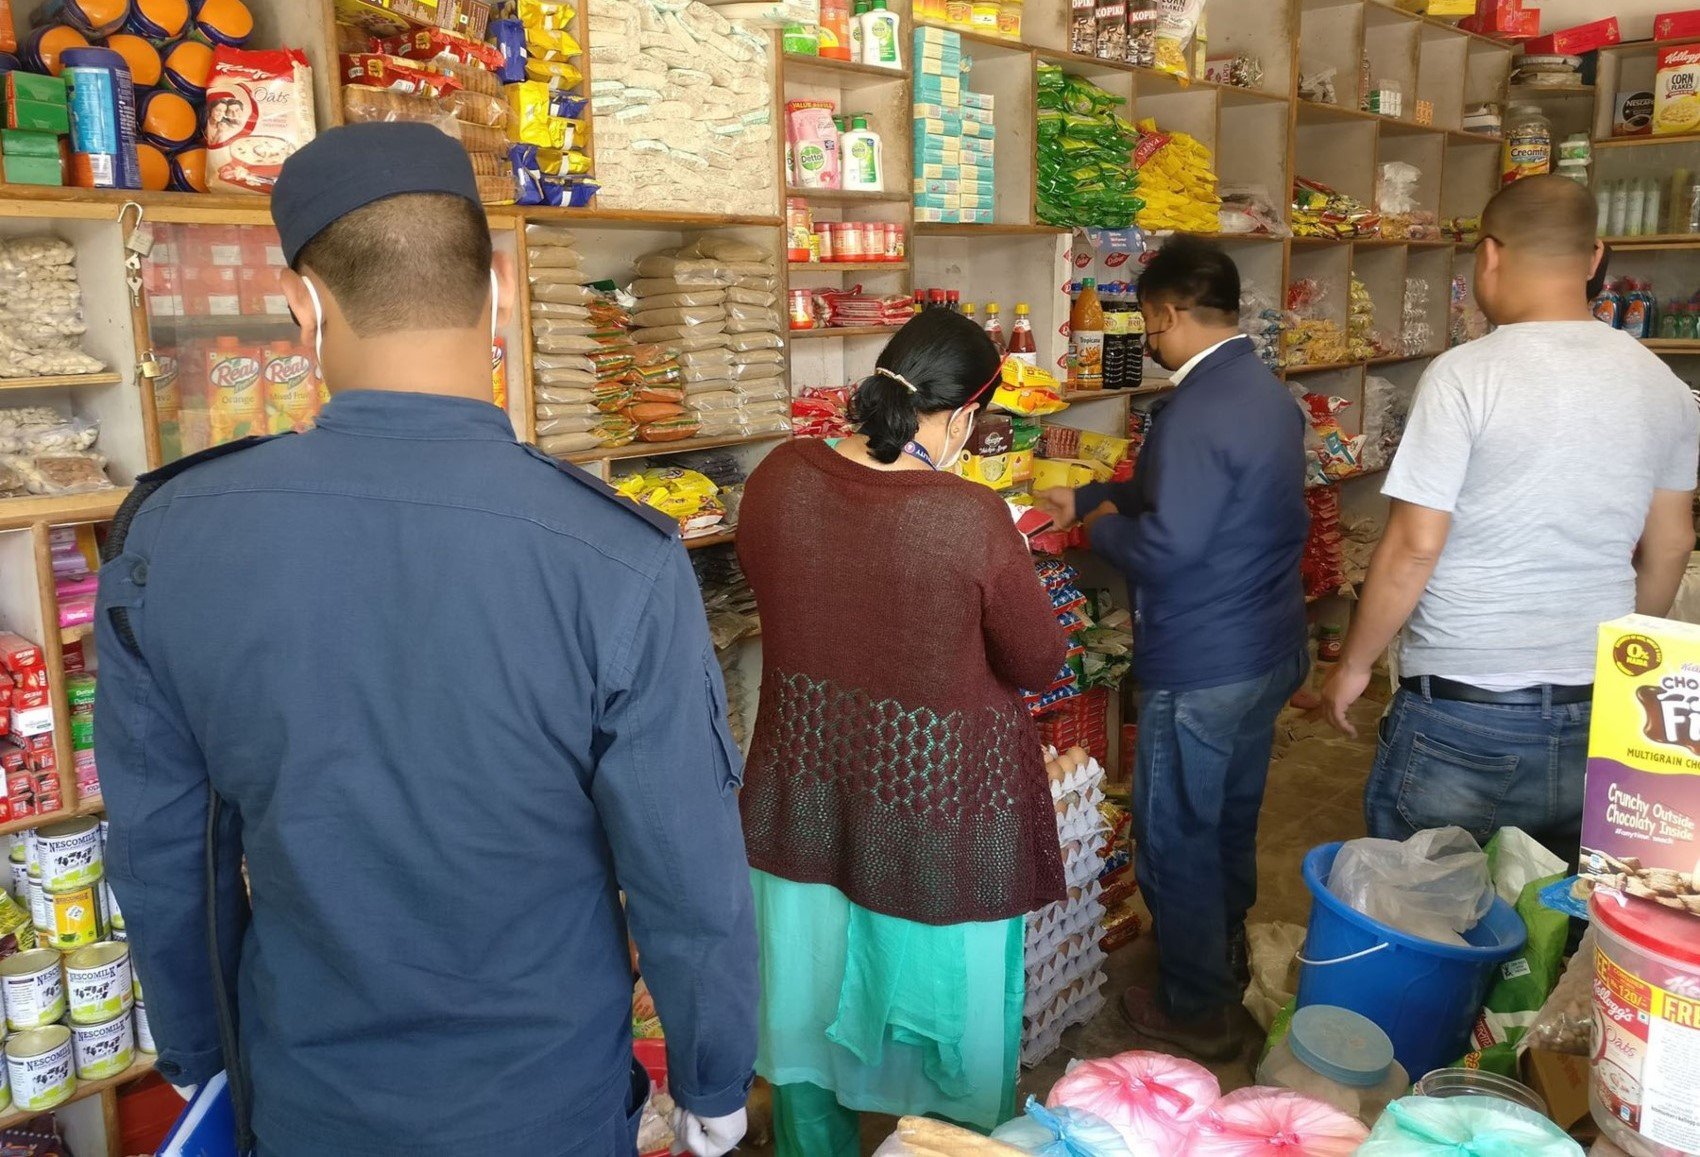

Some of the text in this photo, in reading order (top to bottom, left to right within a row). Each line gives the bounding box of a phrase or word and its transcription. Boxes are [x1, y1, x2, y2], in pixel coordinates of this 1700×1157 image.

[1671, 73, 1694, 85] CORN
[254, 86, 290, 103] Oats
[801, 153, 824, 163] Dettol
[217, 359, 256, 385] Real
[271, 358, 305, 381] Real
[1627, 748, 1683, 767] MULTIGRAIN
[1608, 782, 1695, 830] Crunchy Outside
[1606, 803, 1694, 840] Chocolaty Inside
[49, 831, 97, 852] NESCOMILK
[69, 966, 116, 982] NESCOMILK
[1594, 977, 1635, 1022] Kellogg's
[76, 1019, 126, 1041] NESCOMILK
